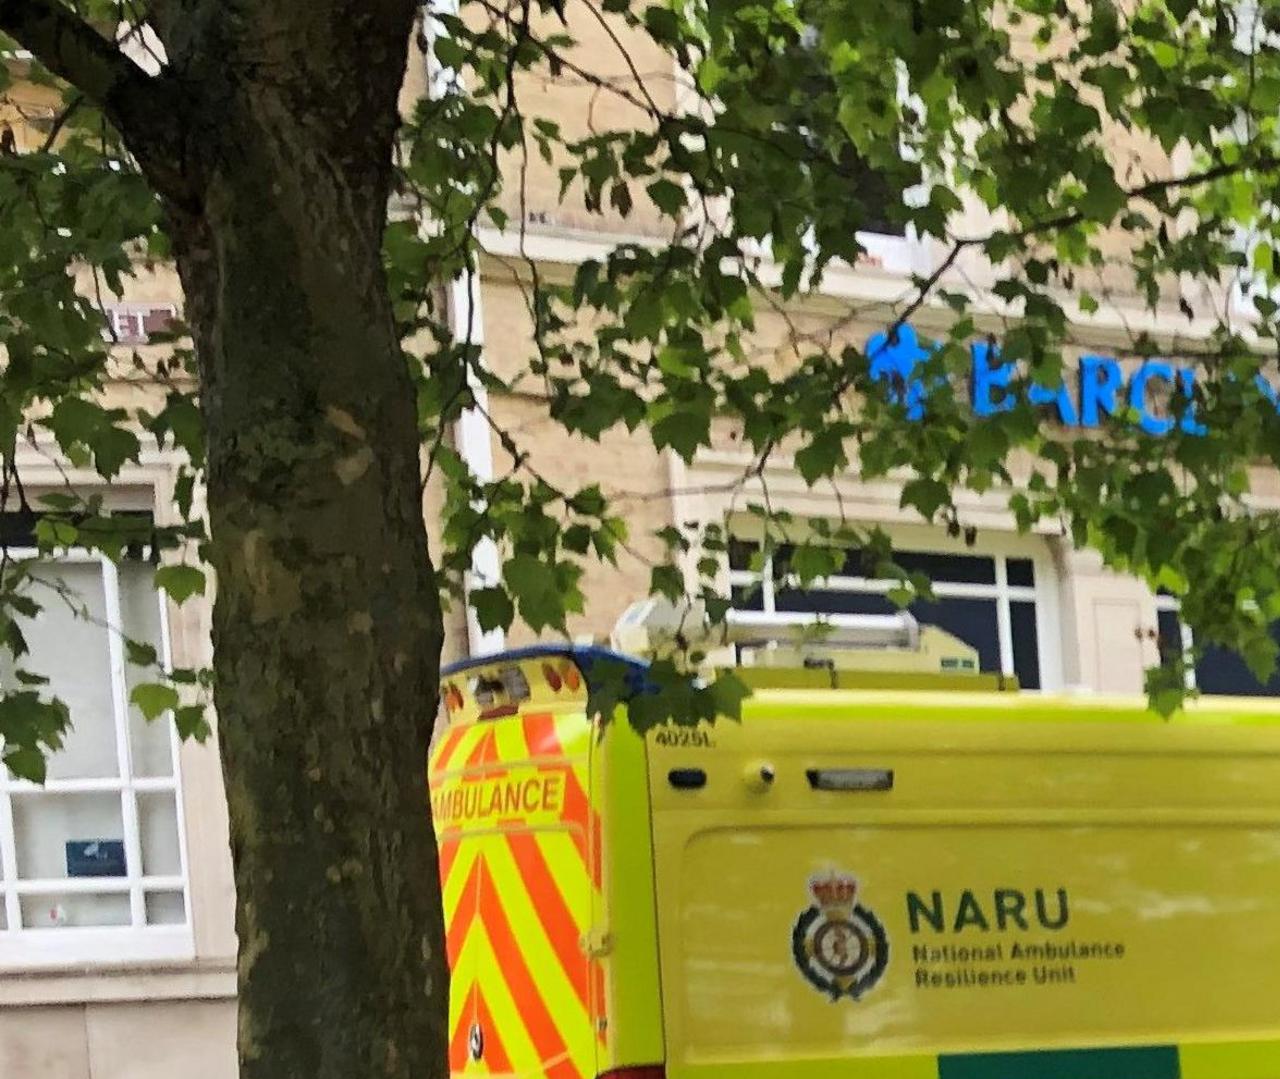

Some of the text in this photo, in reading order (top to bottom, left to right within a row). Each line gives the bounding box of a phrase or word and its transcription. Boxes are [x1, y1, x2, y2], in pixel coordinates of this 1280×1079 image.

[906, 887, 1069, 934] NARU
[913, 941, 1125, 962] National Ambulance
[915, 964, 1076, 987] Resilience Unit
